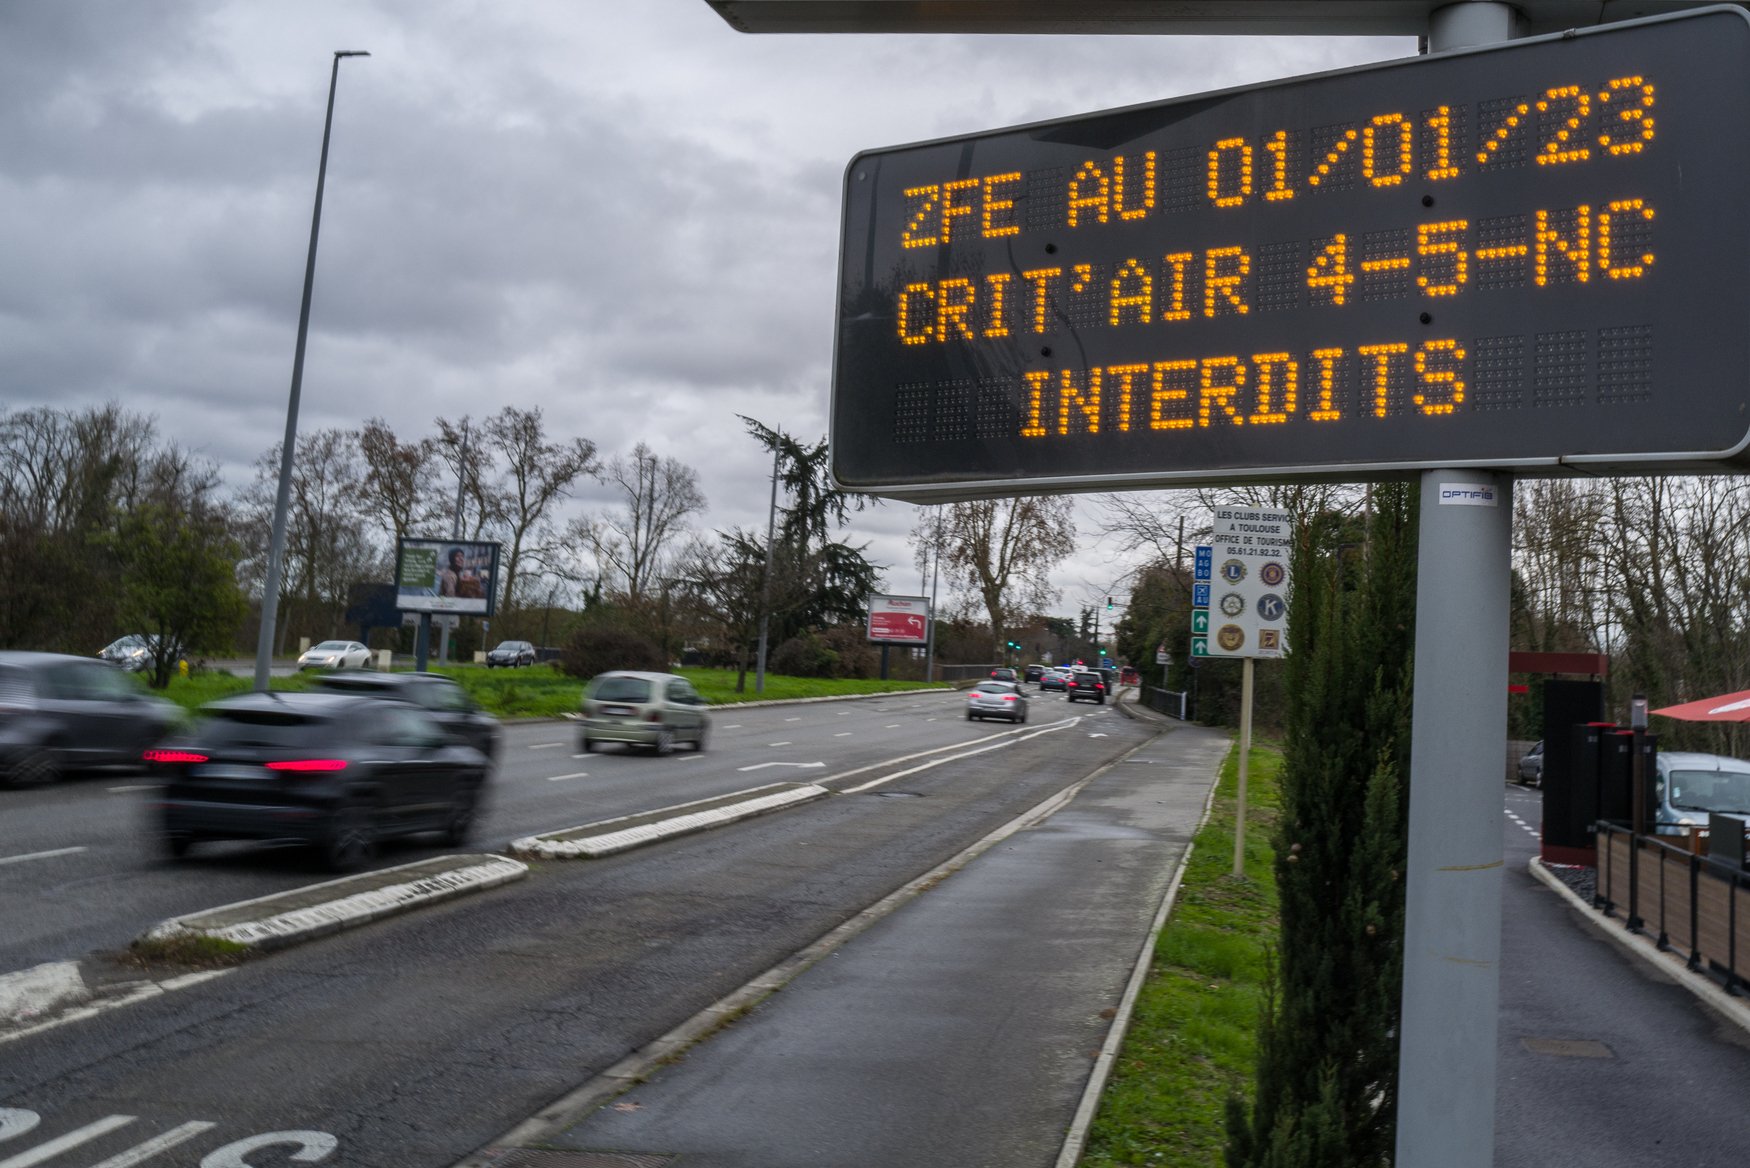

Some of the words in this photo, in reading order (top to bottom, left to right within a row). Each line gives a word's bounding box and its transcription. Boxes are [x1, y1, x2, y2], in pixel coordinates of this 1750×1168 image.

[901, 171, 1022, 249] ZFE
[1067, 151, 1157, 228] AU
[1207, 75, 1656, 208] 01/01/23
[896, 245, 1251, 345] CRIT'AIR
[1306, 198, 1656, 306] 4-5-NC
[1020, 338, 1467, 437] INTERDITS
[1215, 534, 1240, 544] OFFICE
[1243, 536, 1253, 545] DE
[1217, 511, 1232, 520] LES
[1234, 511, 1260, 521] CLUBS
[1230, 523, 1236, 532] A
[1238, 524, 1281, 534] TOULOUSE
